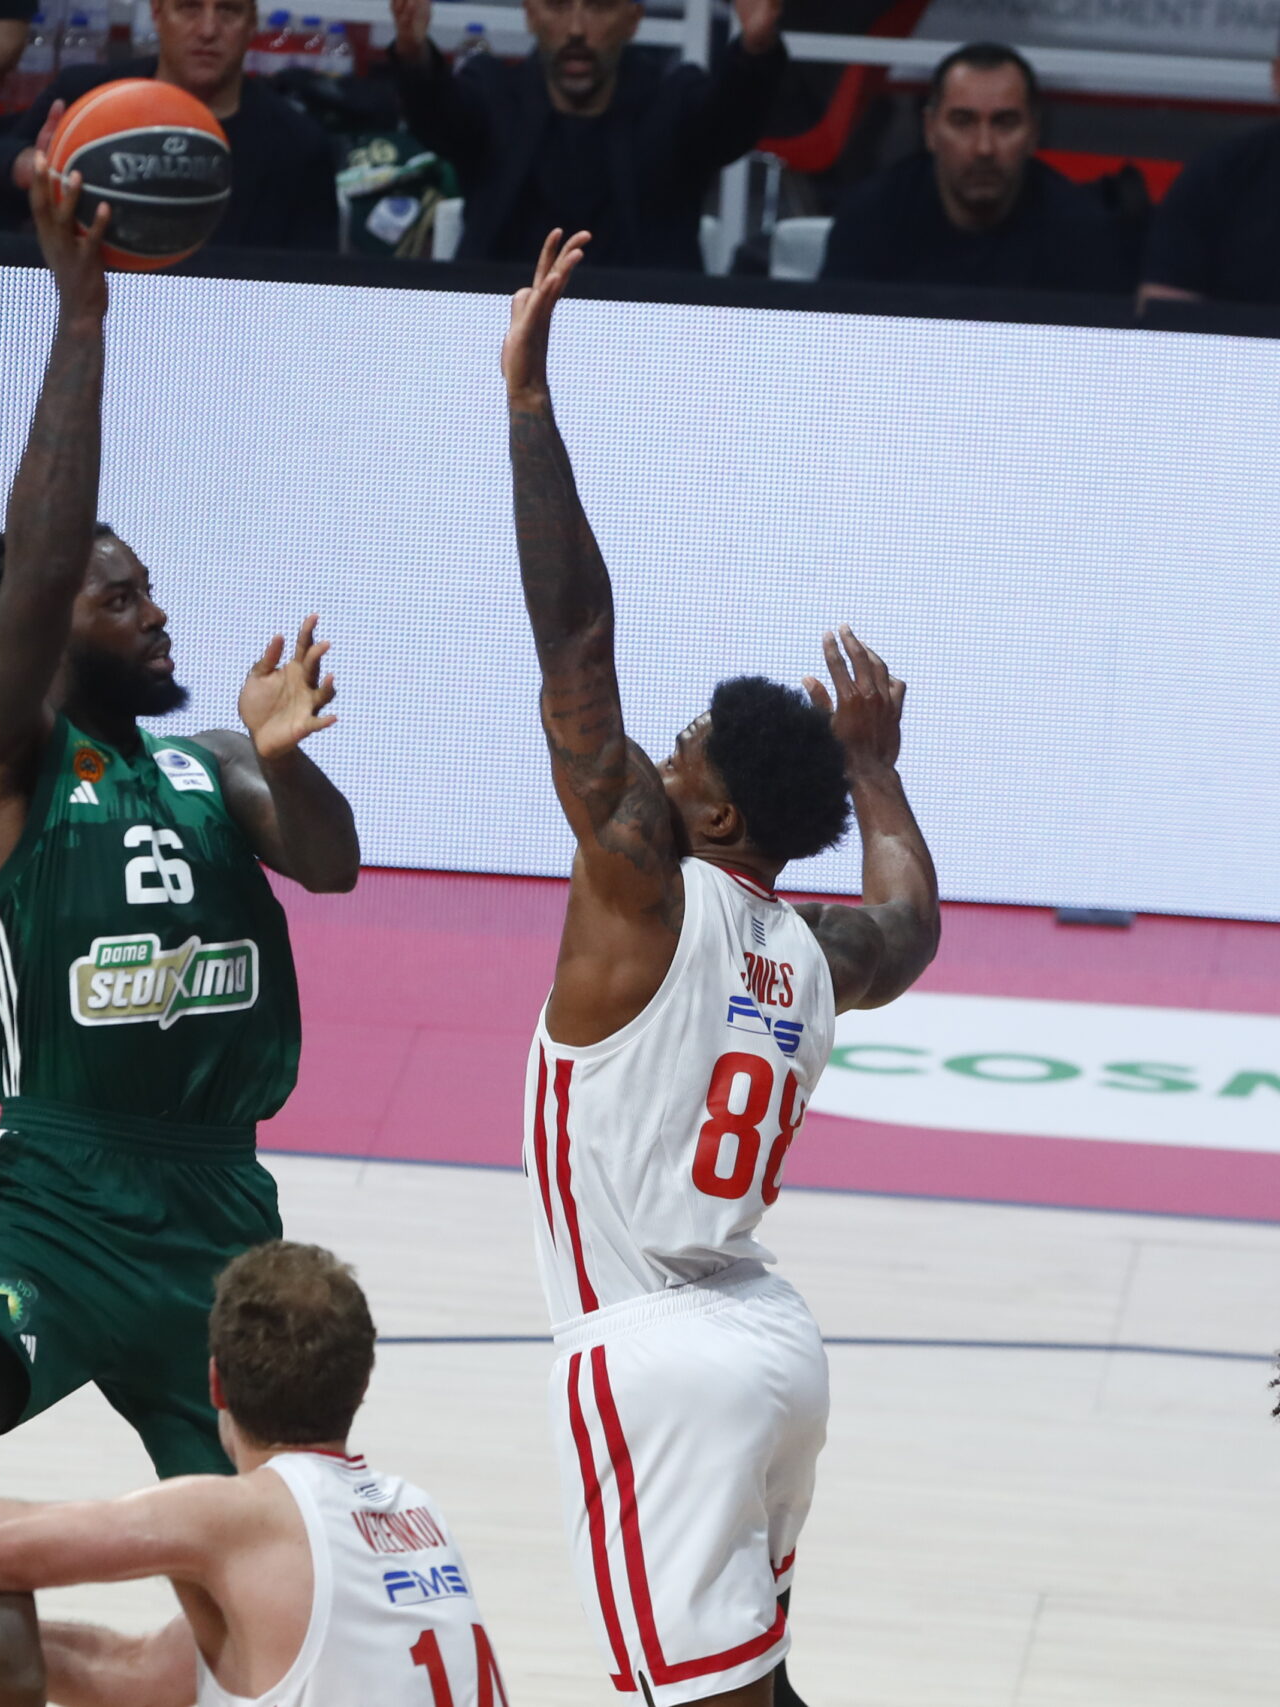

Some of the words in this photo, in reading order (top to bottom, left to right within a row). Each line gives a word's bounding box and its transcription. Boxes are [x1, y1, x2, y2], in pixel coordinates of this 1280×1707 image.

[123, 824, 195, 905] 26
[99, 943, 148, 967] pame
[740, 950, 795, 1009] ONES
